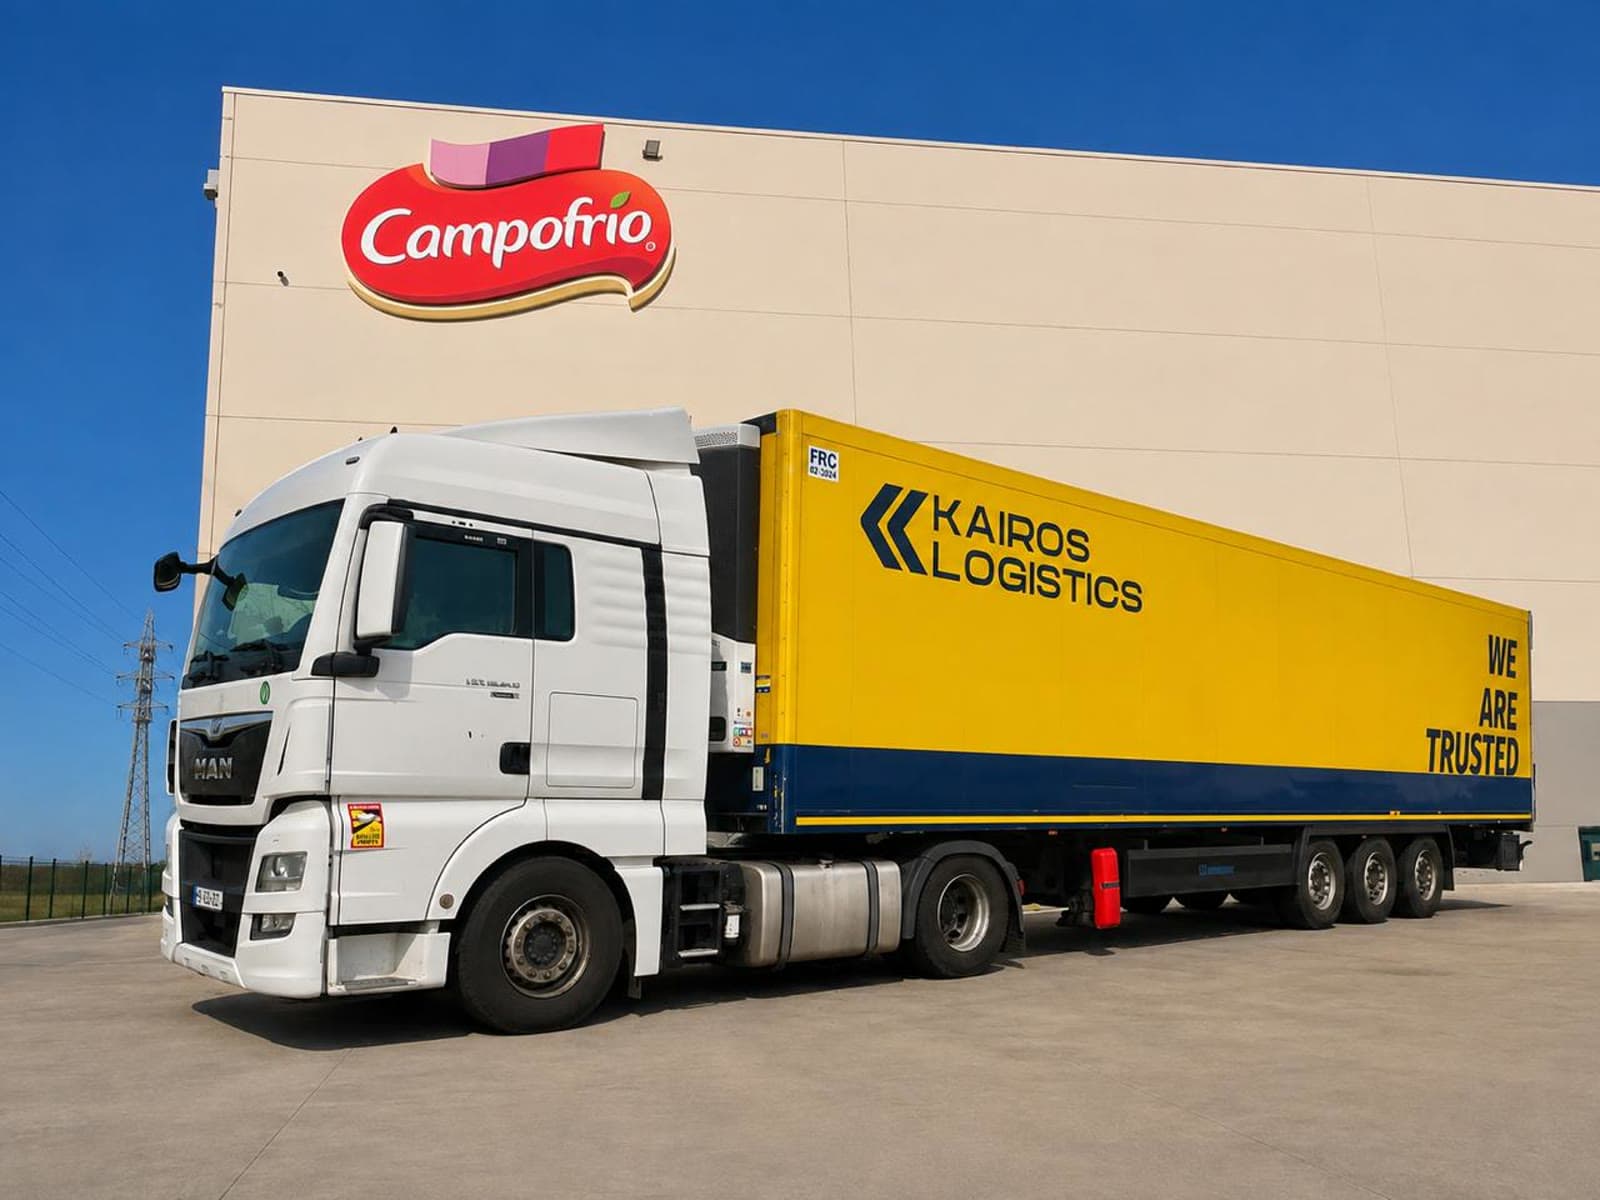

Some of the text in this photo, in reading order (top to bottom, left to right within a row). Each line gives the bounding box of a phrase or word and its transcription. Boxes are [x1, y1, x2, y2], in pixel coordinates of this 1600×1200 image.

[810, 447, 837, 469] FRC
[933, 494, 1090, 563] KAIROS
[932, 540, 1143, 613] LOGISTICS
[1488, 634, 1517, 679] WE
[1479, 687, 1517, 730] ARE
[194, 757, 233, 780] MAN
[1426, 728, 1519, 776] TRUSTED
